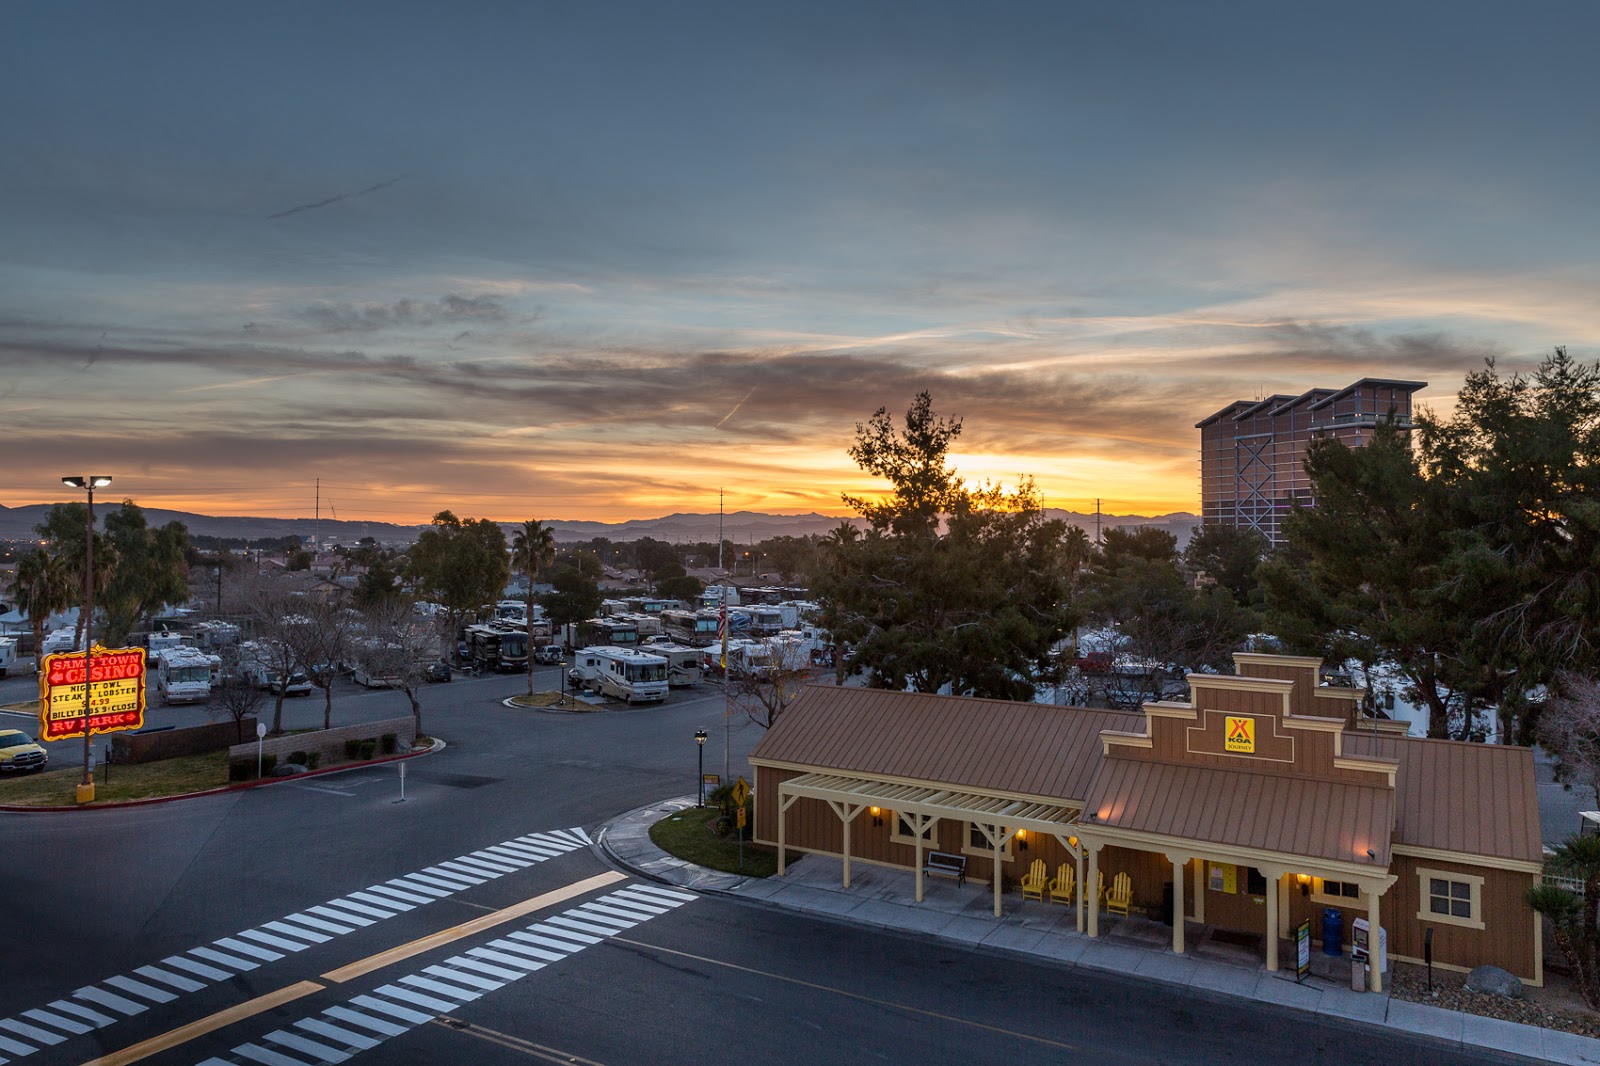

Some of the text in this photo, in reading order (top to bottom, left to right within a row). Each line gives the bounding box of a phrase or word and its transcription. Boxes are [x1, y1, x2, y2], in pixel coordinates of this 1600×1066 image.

[53, 655, 139, 670] SAM'S TOWN
[66, 664, 139, 682] CASINO
[103, 681, 121, 689] OWL
[53, 694, 82, 702] STEAK
[98, 687, 137, 697] LOBSTER
[52, 710, 75, 719] BILLY
[52, 715, 124, 731] RV PARK
